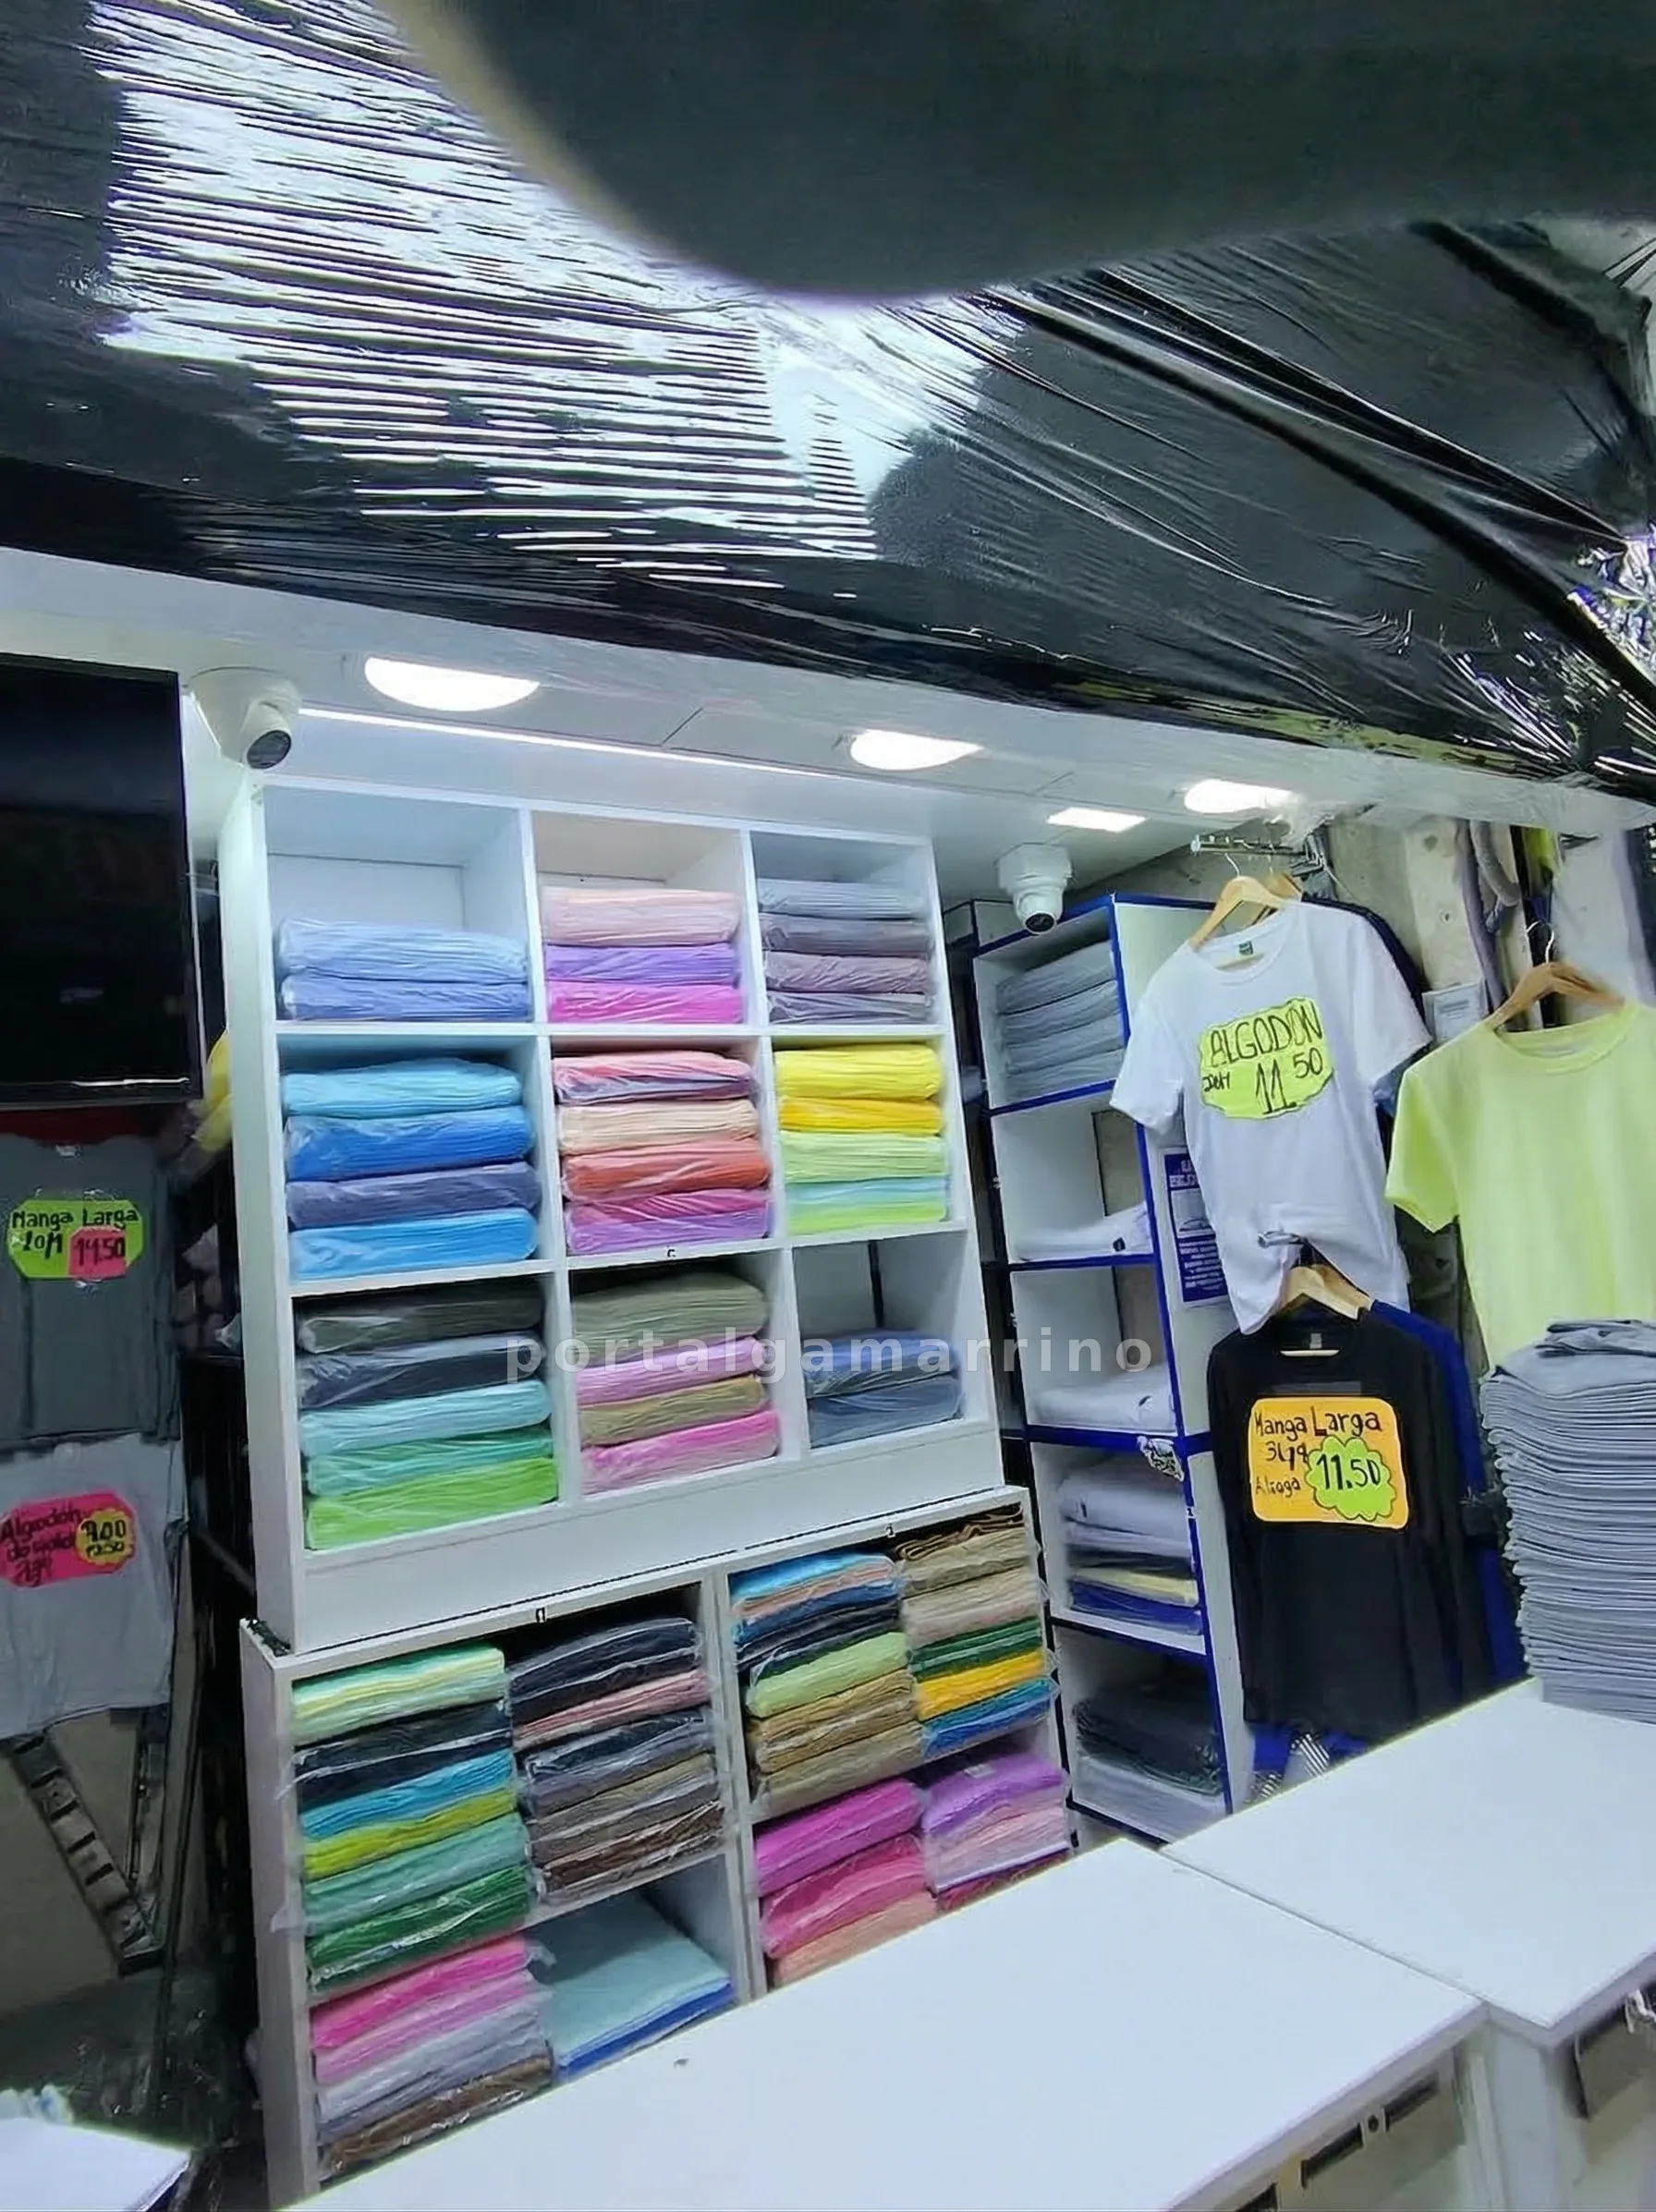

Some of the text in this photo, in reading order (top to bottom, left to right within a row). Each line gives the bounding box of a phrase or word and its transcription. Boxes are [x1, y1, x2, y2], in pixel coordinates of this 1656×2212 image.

[82, 1209, 139, 1230] Larga
[1310, 1405, 1383, 1438] Larga
[1316, 1453, 1382, 1491] 11.50
